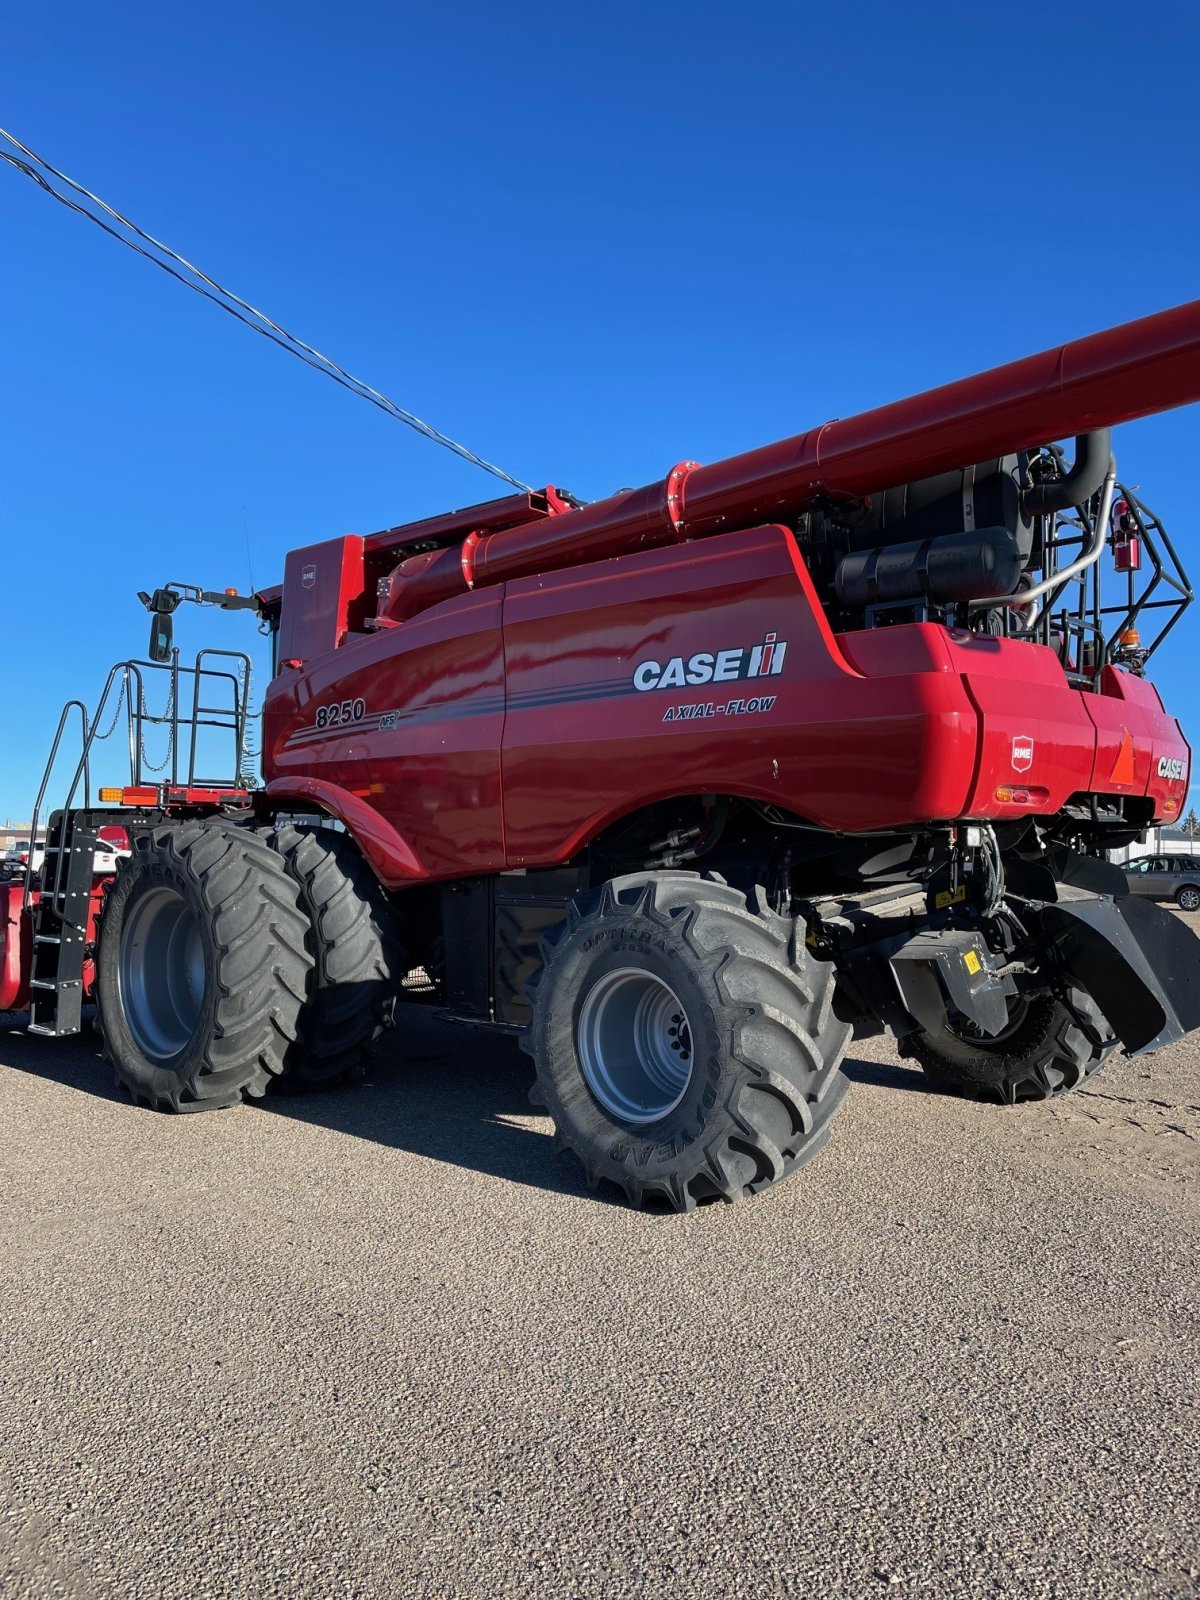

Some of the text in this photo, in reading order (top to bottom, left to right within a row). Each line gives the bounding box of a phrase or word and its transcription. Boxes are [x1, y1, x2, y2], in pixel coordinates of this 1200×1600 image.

[633, 648, 744, 692] CASE
[316, 698, 366, 729] 8250
[662, 696, 777, 722] AXIAL-FLOW
[1013, 747, 1032, 759] RME
[1157, 755, 1182, 779] CASE
